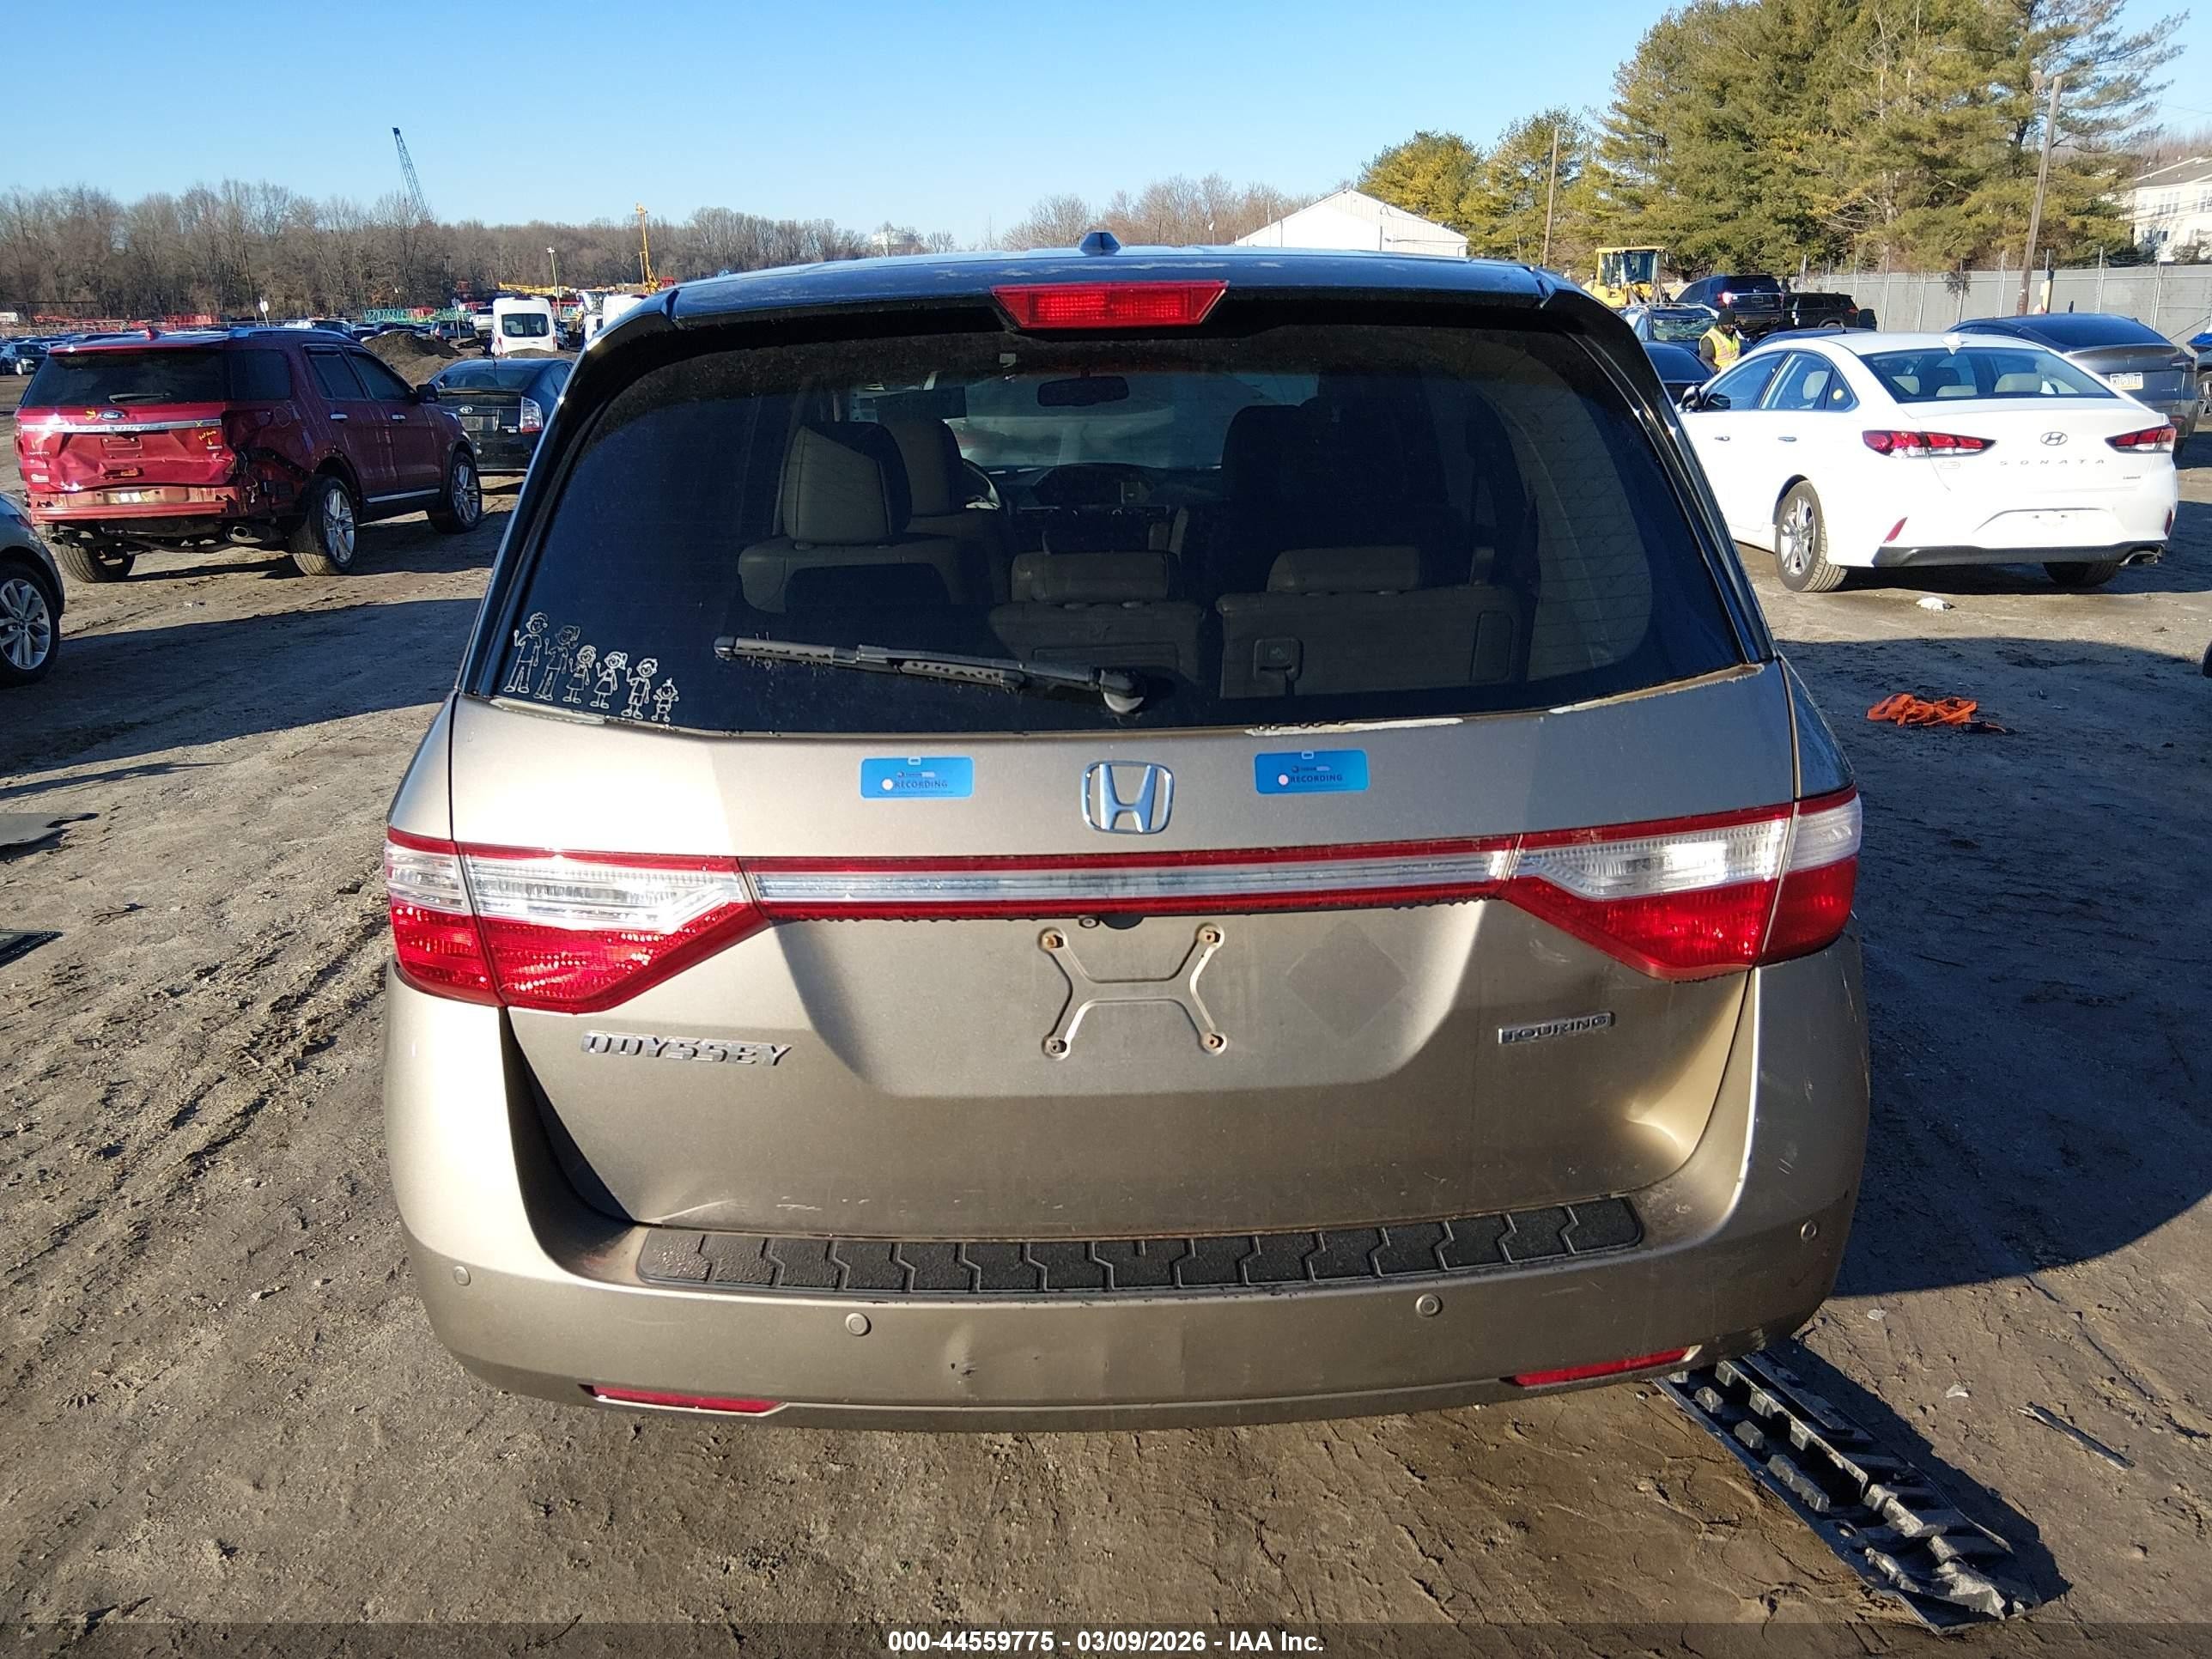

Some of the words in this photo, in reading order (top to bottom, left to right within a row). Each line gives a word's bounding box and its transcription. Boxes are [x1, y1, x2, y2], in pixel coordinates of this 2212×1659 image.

[894, 779, 949, 789] RECORDING
[1290, 774, 1343, 783] RECORDING
[1498, 1012, 1614, 1044] TOURING
[581, 1030, 793, 1066] ODYSSEY
